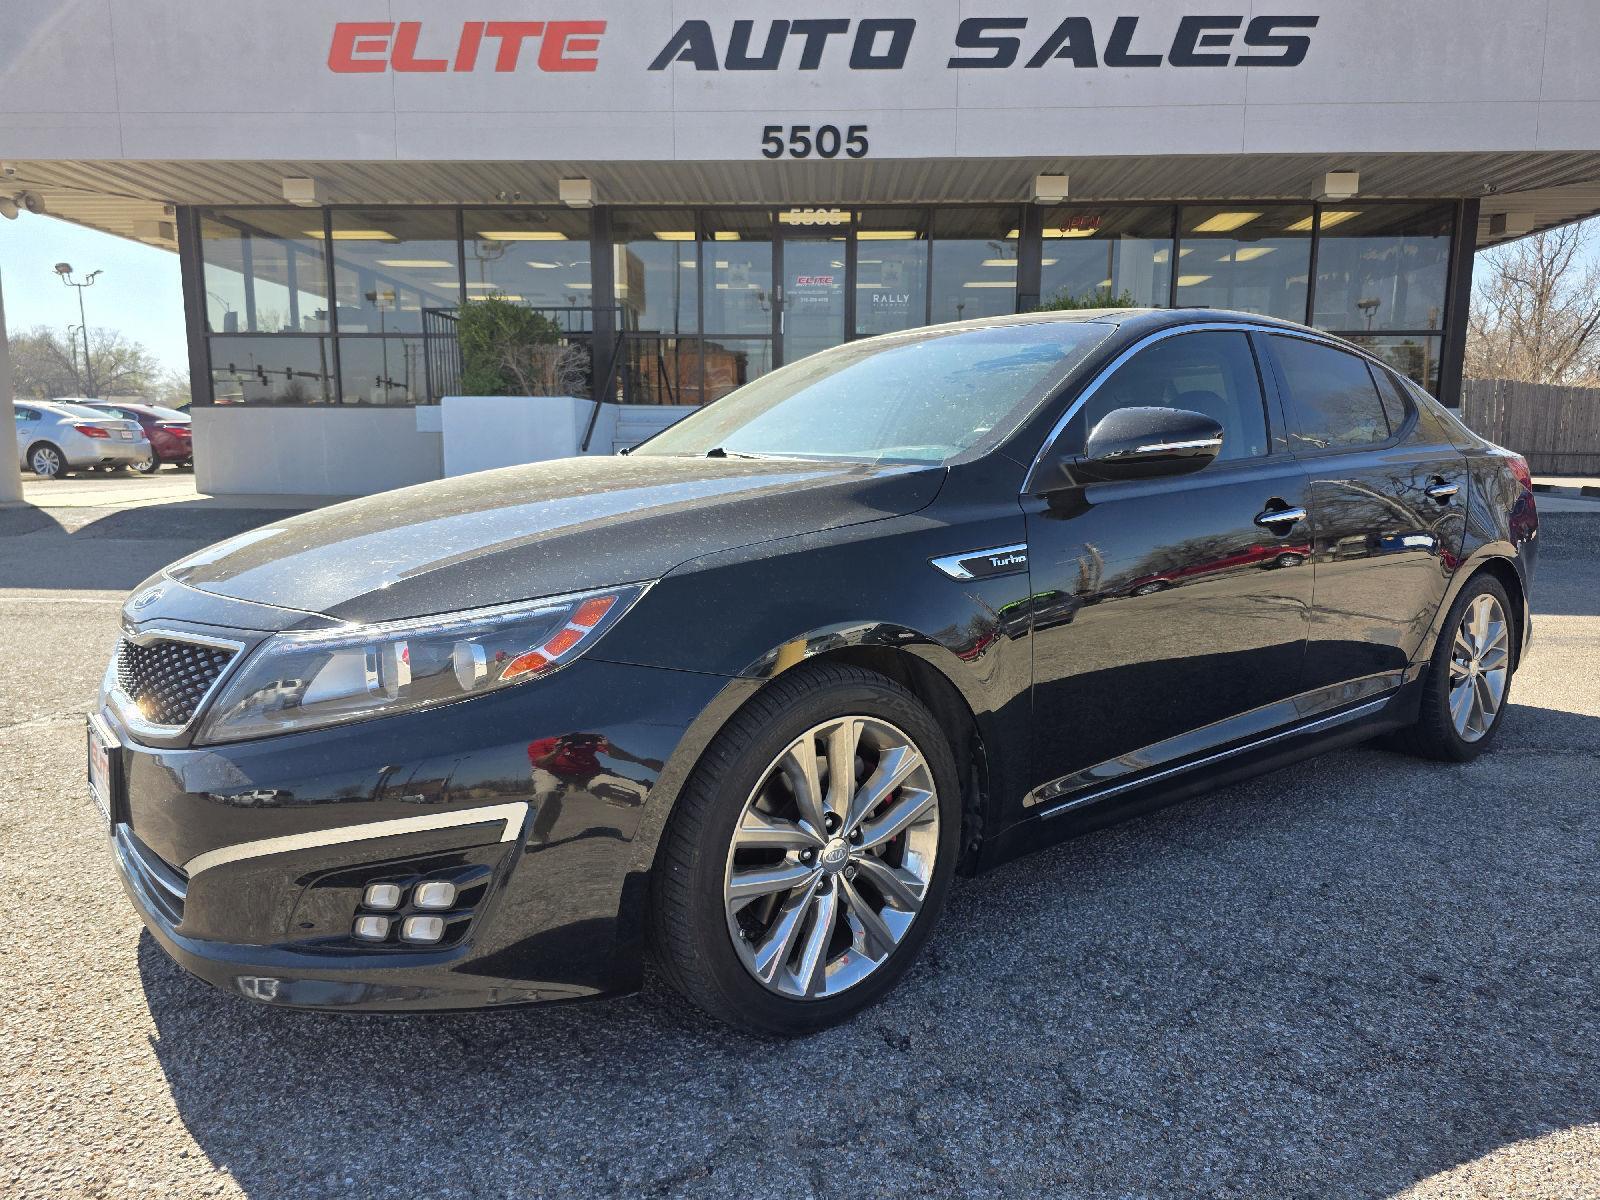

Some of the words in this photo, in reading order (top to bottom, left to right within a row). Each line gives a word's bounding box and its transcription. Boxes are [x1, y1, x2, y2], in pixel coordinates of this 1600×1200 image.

[327, 20, 607, 73] ELITE
[648, 18, 917, 71] AUTO
[947, 15, 1320, 69] SALES
[761, 125, 870, 158] 5505
[789, 208, 841, 225] 5505
[1060, 215, 1103, 232] OPEN
[797, 276, 833, 284] ELITE
[873, 294, 910, 303] RALLY
[988, 554, 1027, 567] Turbo
[828, 849, 844, 861] KIA
